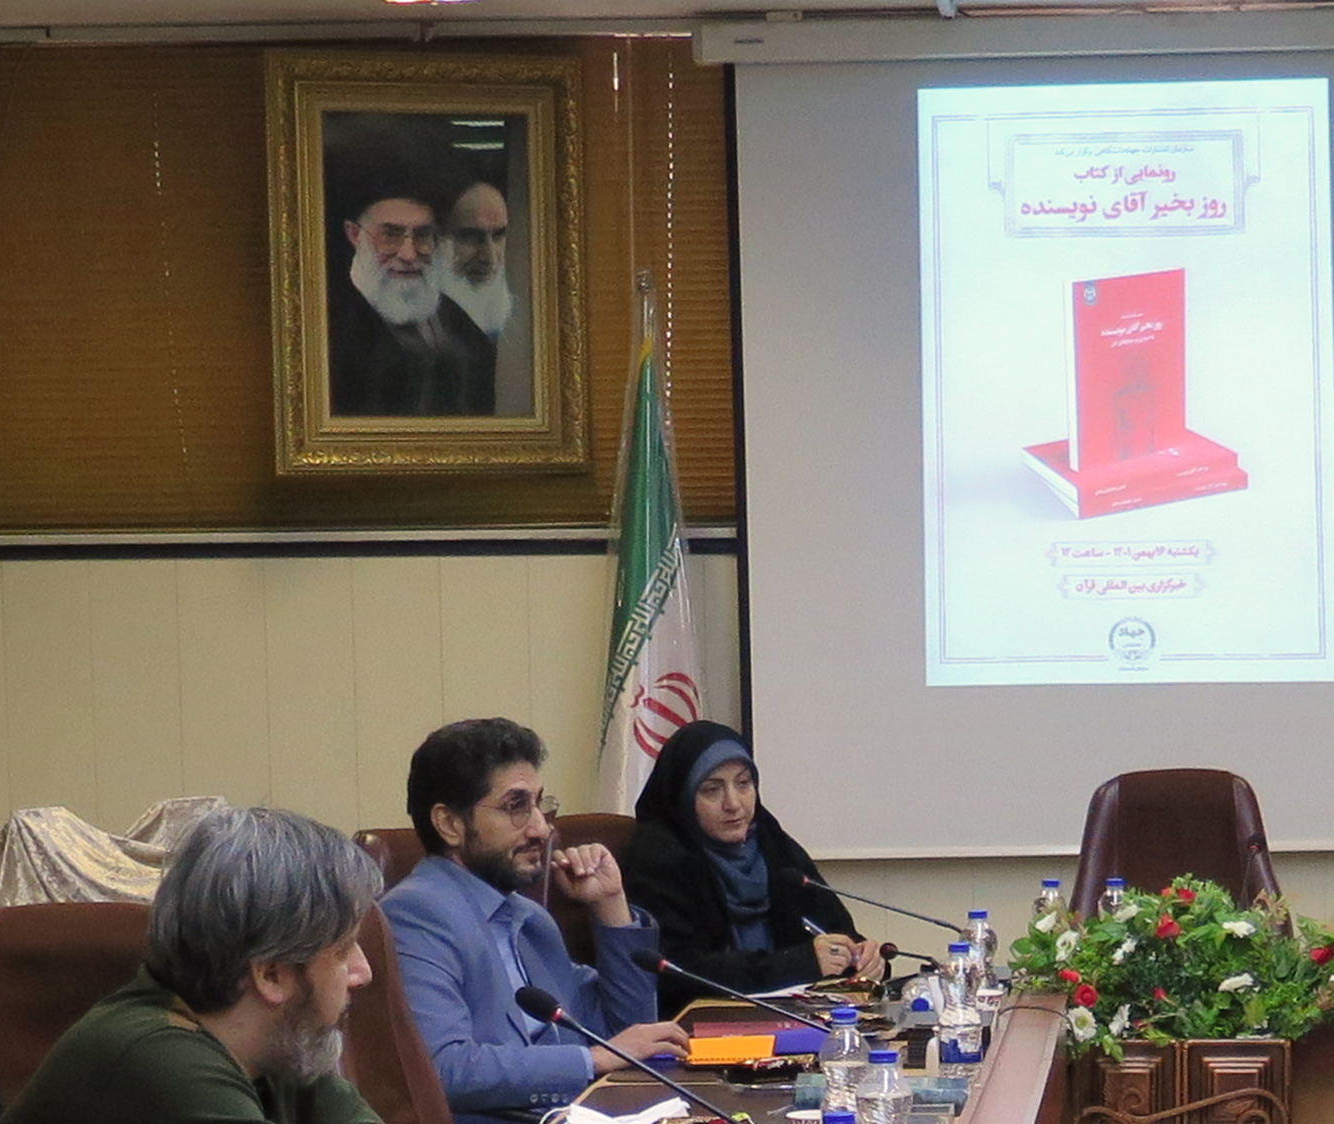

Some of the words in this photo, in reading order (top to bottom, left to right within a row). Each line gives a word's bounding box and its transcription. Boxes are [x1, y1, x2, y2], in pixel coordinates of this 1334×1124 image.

[1073, 164, 1110, 184] کتاب
[1110, 165, 1124, 184] از
[1124, 163, 1177, 185] رونمایی
[1020, 195, 1097, 222] نویسنده
[1102, 190, 1148, 219] آقای
[1149, 193, 1195, 220] بخیر
[1196, 196, 1227, 219] روز
